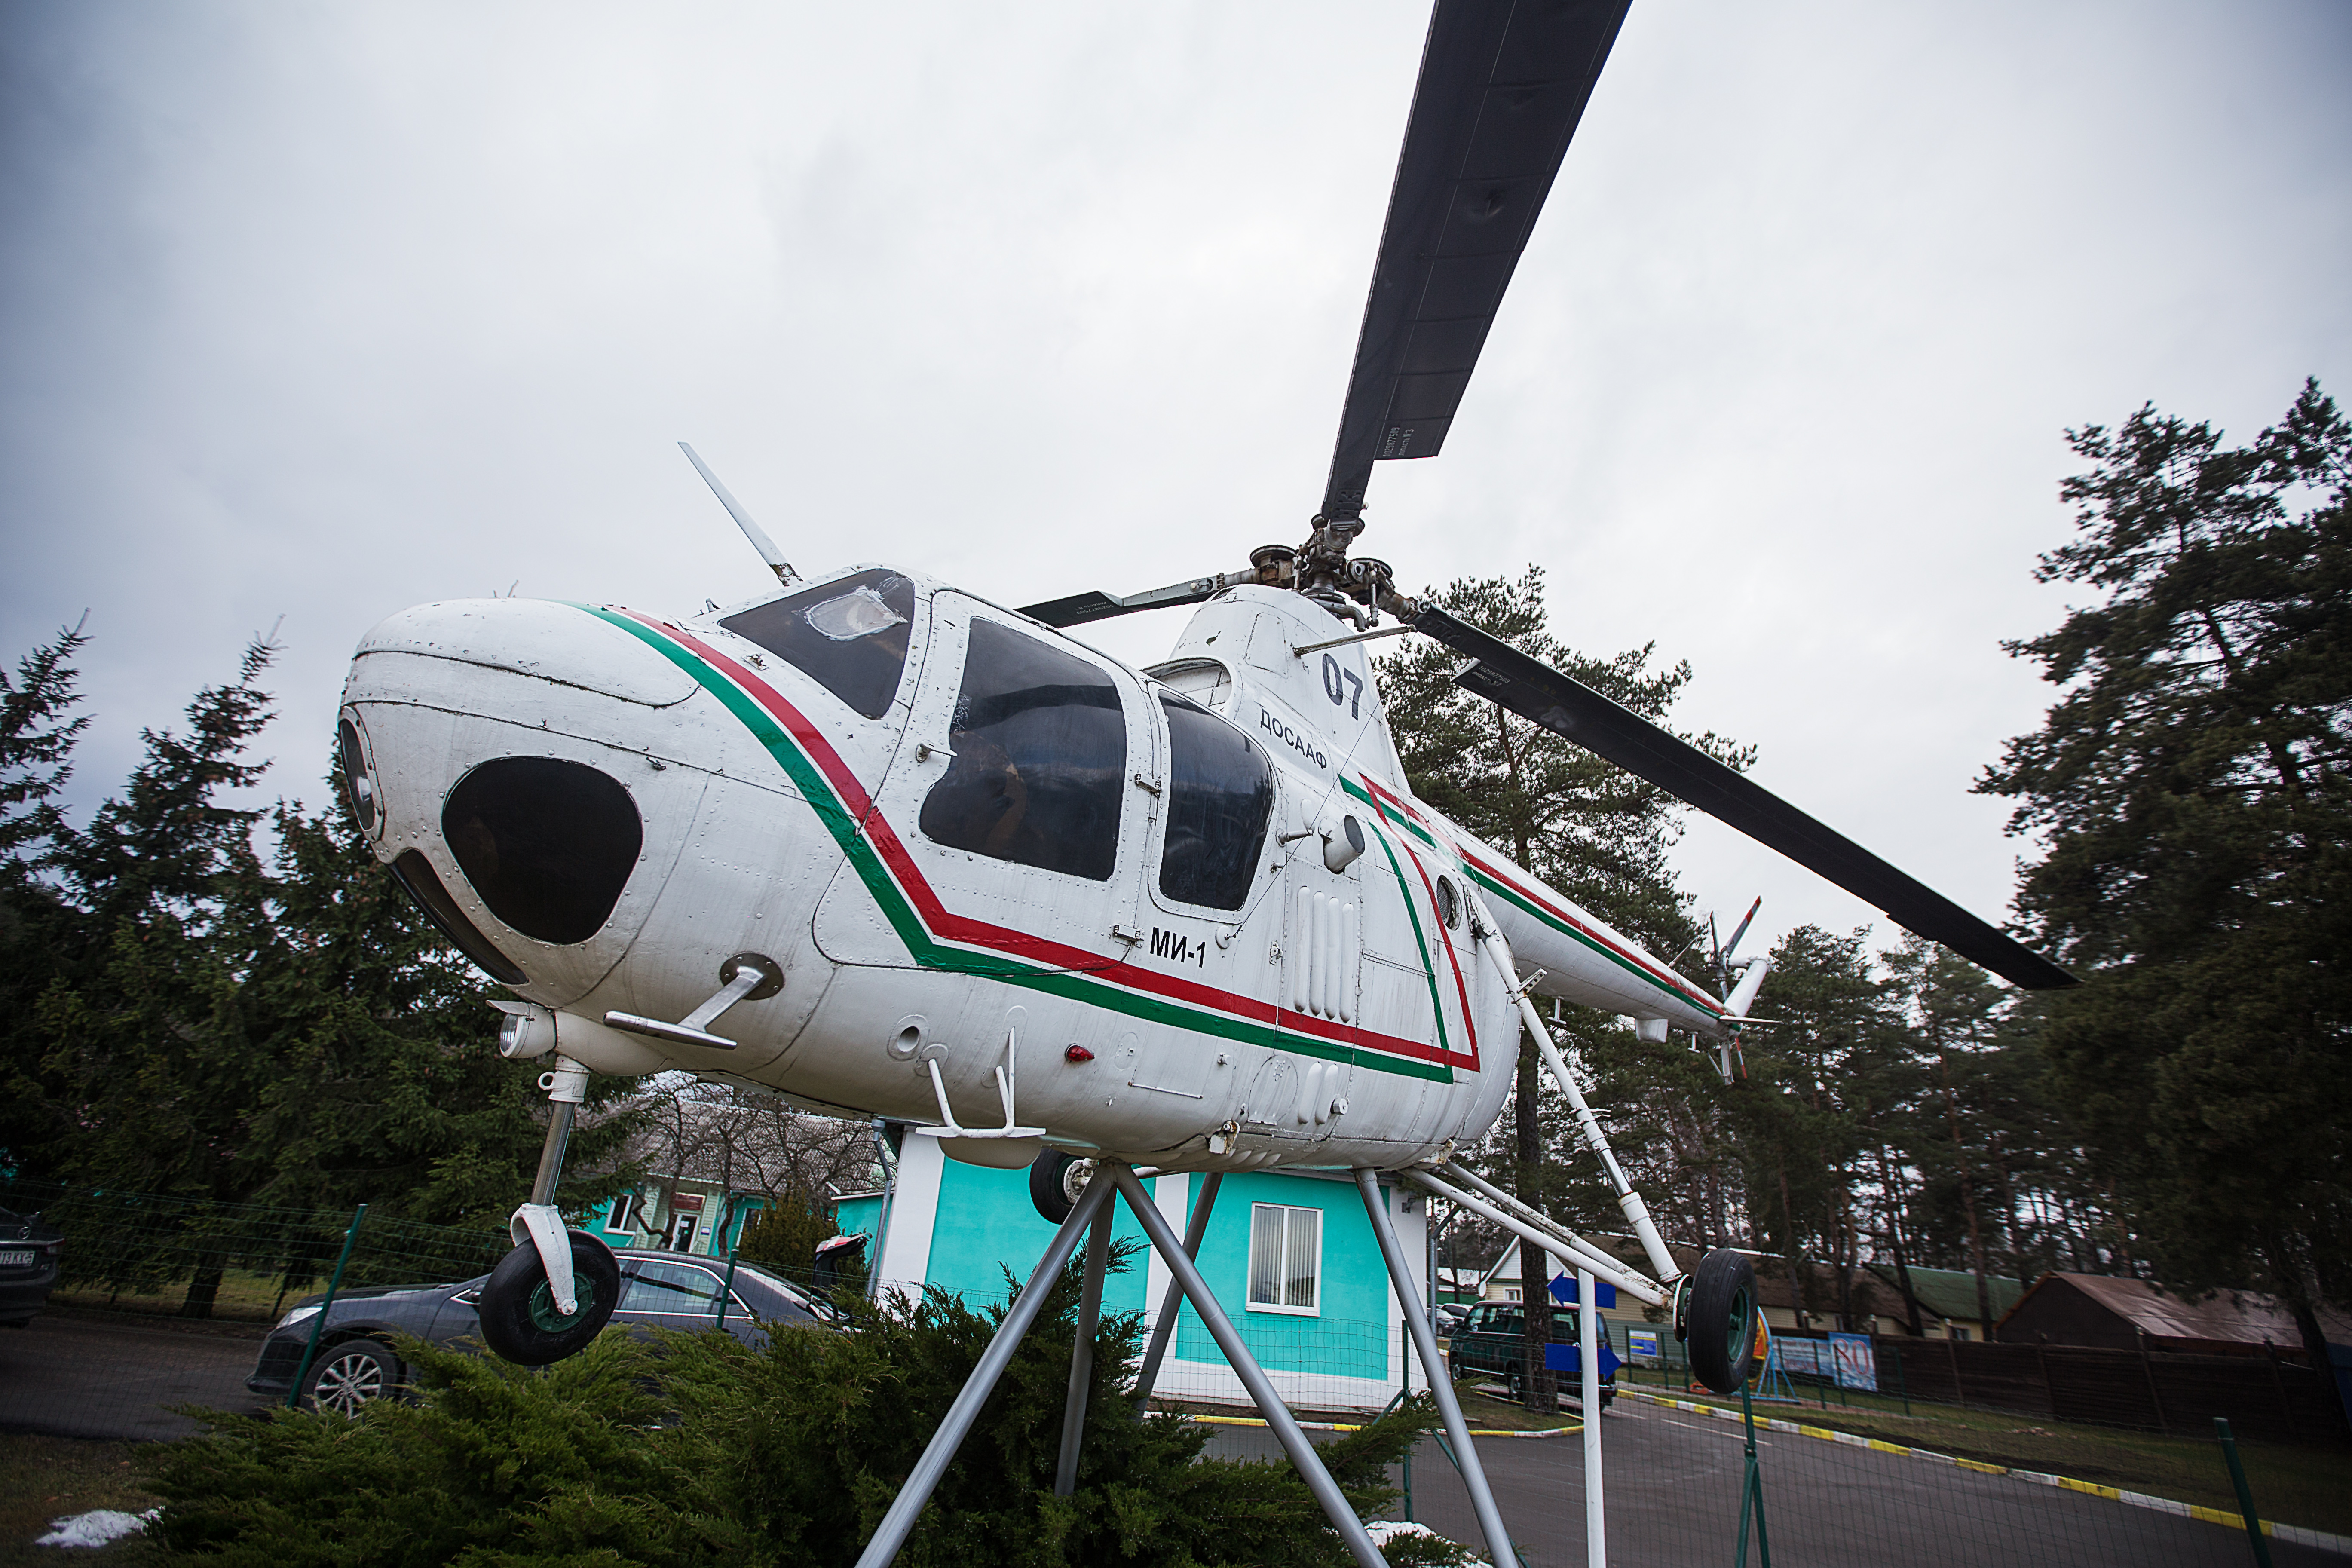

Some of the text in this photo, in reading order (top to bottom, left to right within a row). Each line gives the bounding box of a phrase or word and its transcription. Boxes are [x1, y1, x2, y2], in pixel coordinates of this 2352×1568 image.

[1322, 653, 1363, 721] 07
[1260, 707, 1327, 769] ДОСААФ
[1150, 927, 1206, 968] МИ-1
[1834, 1338, 1869, 1375] 80
